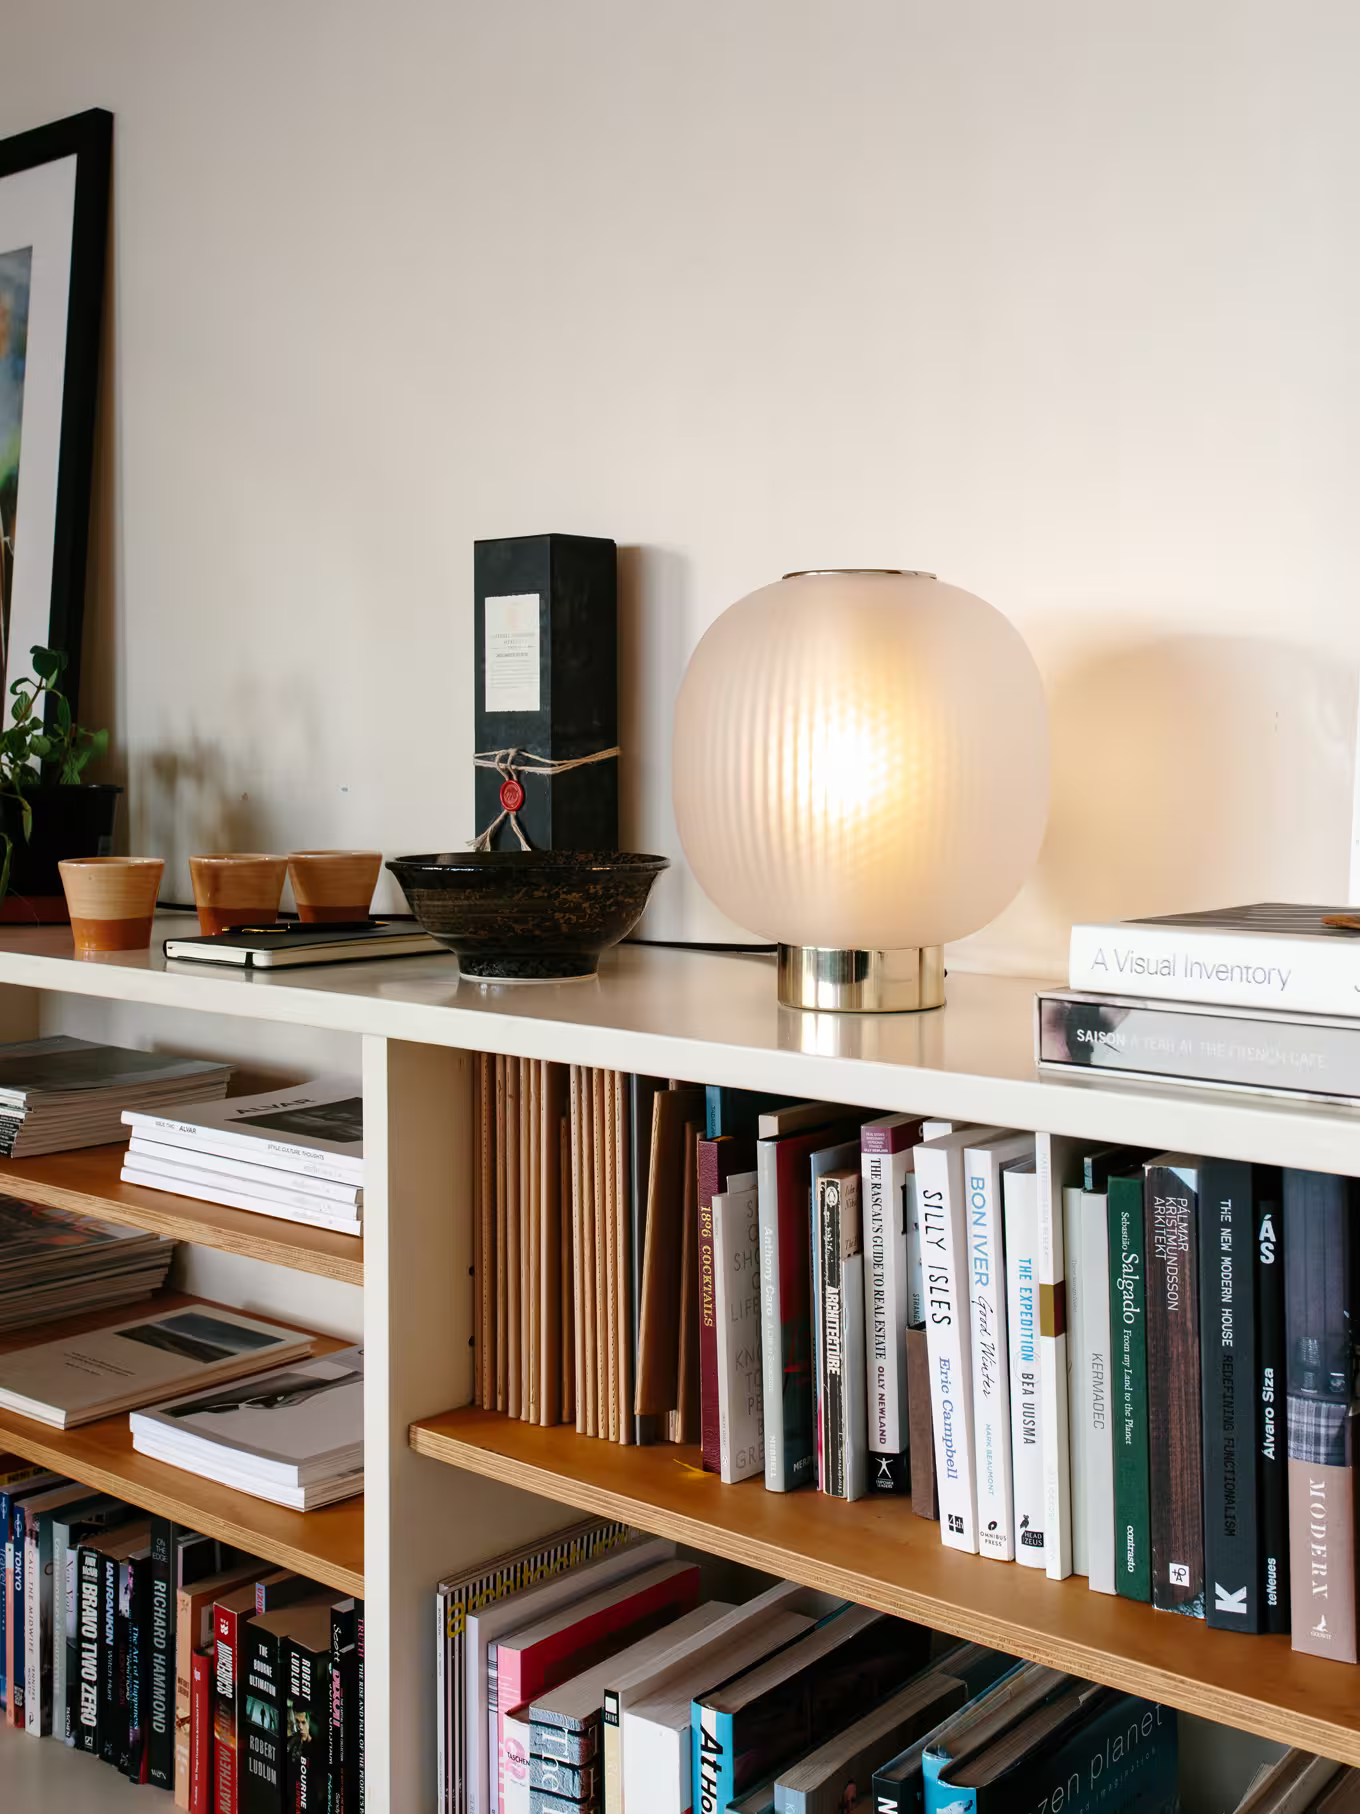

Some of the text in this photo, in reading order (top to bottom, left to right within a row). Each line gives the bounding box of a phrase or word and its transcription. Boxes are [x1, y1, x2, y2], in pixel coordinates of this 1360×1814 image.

[1091, 948, 1293, 991] A Visual Inventory
[1076, 1029, 1126, 1047] SAISON
[235, 1097, 315, 1115] ALVAR
[179, 1125, 197, 1135] ALVAR
[971, 1177, 987, 1226] BON
[1154, 1195, 1167, 1260] ARKITEKT
[764, 1226, 775, 1283] Anthony
[973, 1233, 989, 1287] IVER
[1166, 1196, 1179, 1311] KRISTMUNDSSON
[702, 1245, 714, 1327] COCKTAILS
[766, 1286, 775, 1316] Caro
[870, 1158, 887, 1445] THE RASCAL'S GUIDE TO REAL ESTATE OLLY NEWLAND
[825, 1286, 841, 1376] ARCHITECTURE
[923, 1190, 958, 1480] SILLY ISLES Eric Campbell
[1117, 1212, 1140, 1444] Sebastião Salgado From my Land to the Planet
[979, 1342, 997, 1400] Winter
[1019, 1259, 1036, 1445] THE EXPEDITION BEA UUSMA
[1220, 1199, 1235, 1538] THE NEW MODERN HOUSE REDEFINING FUNCTIONALISM
[1092, 1352, 1105, 1429] KERMADEC
[1262, 1368, 1275, 1460] Álvaro Siza
[985, 1423, 993, 1448] MARK
[985, 1450, 995, 1496] BEAUMONT
[980, 1531, 1007, 1541] OMNIBUS
[985, 1538, 1003, 1547] PRESS
[1024, 1538, 1043, 1546] ZEUS
[1025, 1532, 1043, 1540] HEAD
[1127, 1525, 1135, 1573] contrasto
[1309, 1478, 1328, 1600] MODERN
[106, 1561, 114, 1587] IAN
[1215, 1581, 1247, 1614] K
[1267, 1558, 1276, 1606] teNeues
[82, 1582, 98, 1640] BRAVO
[105, 1587, 114, 1646] RANKIN
[81, 1642, 98, 1682] TWO
[153, 1580, 166, 1733] RICHARD HAMMOND
[258, 1643, 268, 1658] THE
[333, 1624, 341, 1662] Scott
[133, 1665, 139, 1677] of
[217, 1640, 233, 1699] SCARECROW
[249, 1674, 276, 1697] ULTIMATUM
[253, 1659, 273, 1678] BOURNE
[291, 1651, 300, 1697] LUDLUM
[302, 1658, 311, 1701] ROBERT
[81, 1682, 97, 1727] ZERO
[249, 1734, 276, 1762] ROBERT
[358, 1739, 365, 1751] OF
[507, 1751, 530, 1766] TASCHEN
[541, 1727, 570, 1792] The
[1038, 1704, 1163, 1814] zen planet
[219, 1746, 232, 1814] MATTHEW
[248, 1756, 277, 1786] LUDLUM
[700, 1725, 723, 1814] At Ho
